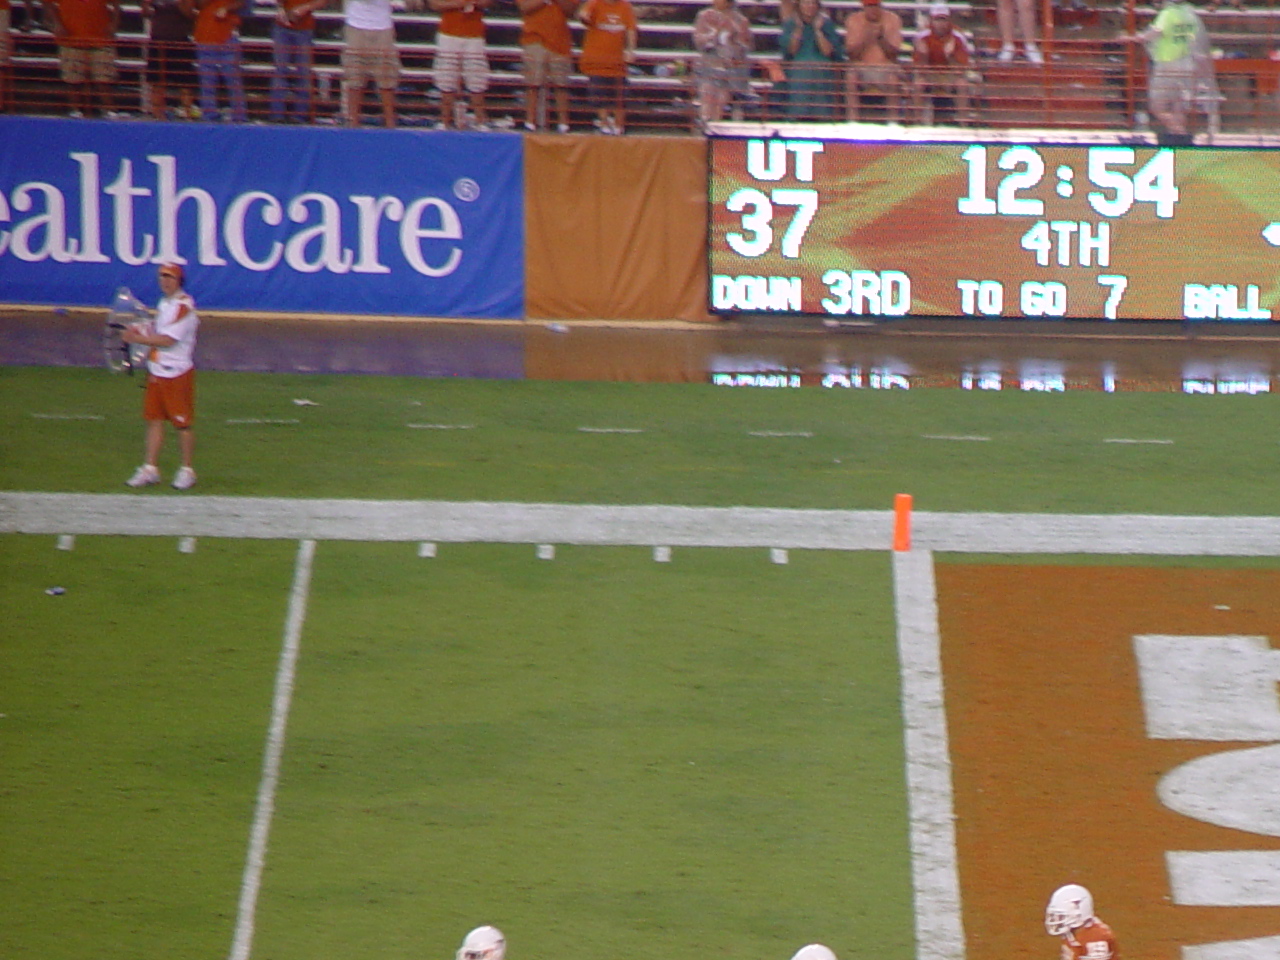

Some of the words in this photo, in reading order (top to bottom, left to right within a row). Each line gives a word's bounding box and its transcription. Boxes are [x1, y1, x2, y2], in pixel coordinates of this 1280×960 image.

[747, 140, 823, 181] UT
[958, 145, 1178, 218] 12:54
[0, 152, 463, 277] althcare
[726, 188, 818, 258] 37
[1021, 221, 1109, 267] 4TH
[712, 275, 801, 311] DOWN
[821, 270, 911, 315] 3RD
[957, 280, 1003, 316] TO
[1020, 282, 1067, 316] GO
[1098, 275, 1128, 319] 7
[1183, 284, 1272, 319] BALL
